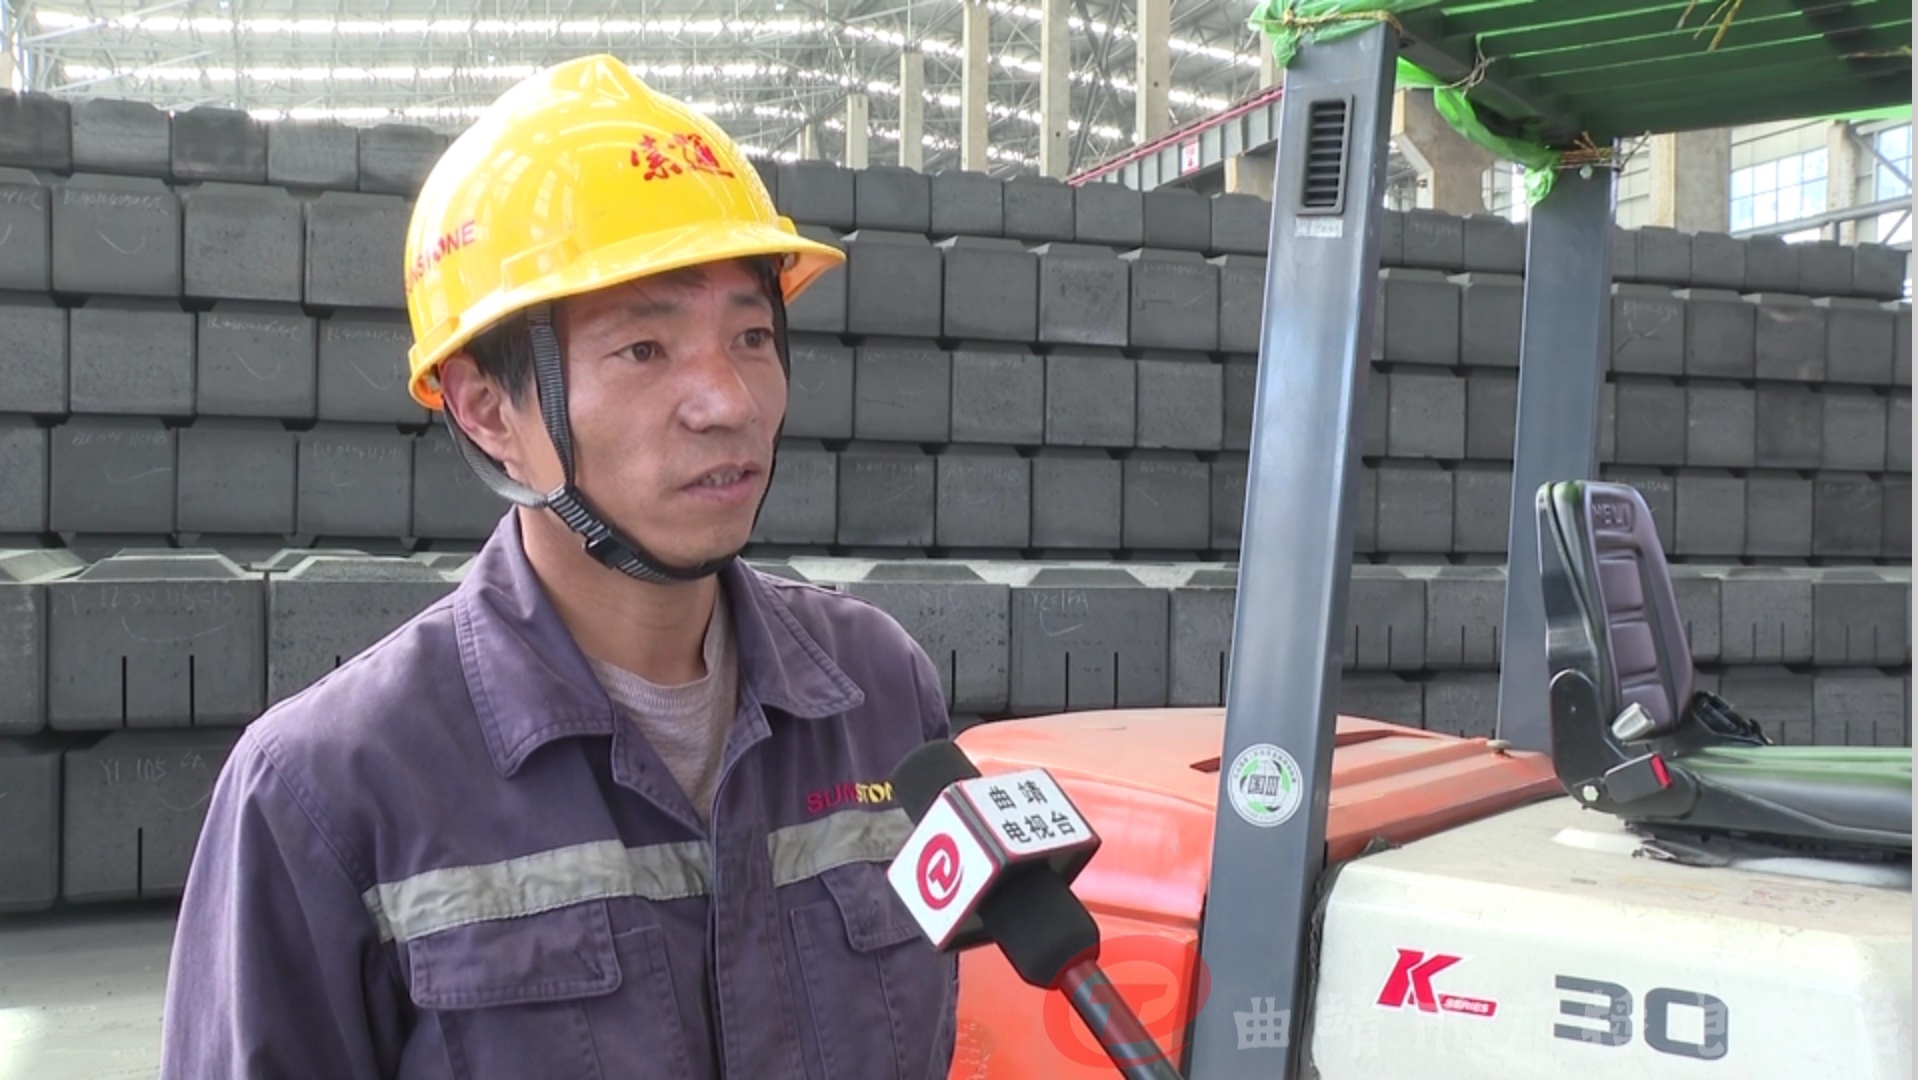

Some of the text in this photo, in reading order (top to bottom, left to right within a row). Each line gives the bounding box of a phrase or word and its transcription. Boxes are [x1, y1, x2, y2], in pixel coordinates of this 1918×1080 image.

[988, 780, 1048, 811] 曲靖
[1001, 811, 1077, 844] 电视台
[1375, 946, 1464, 1014] K
[1442, 996, 1490, 1014] SERIES
[1554, 974, 1729, 1061] 30
